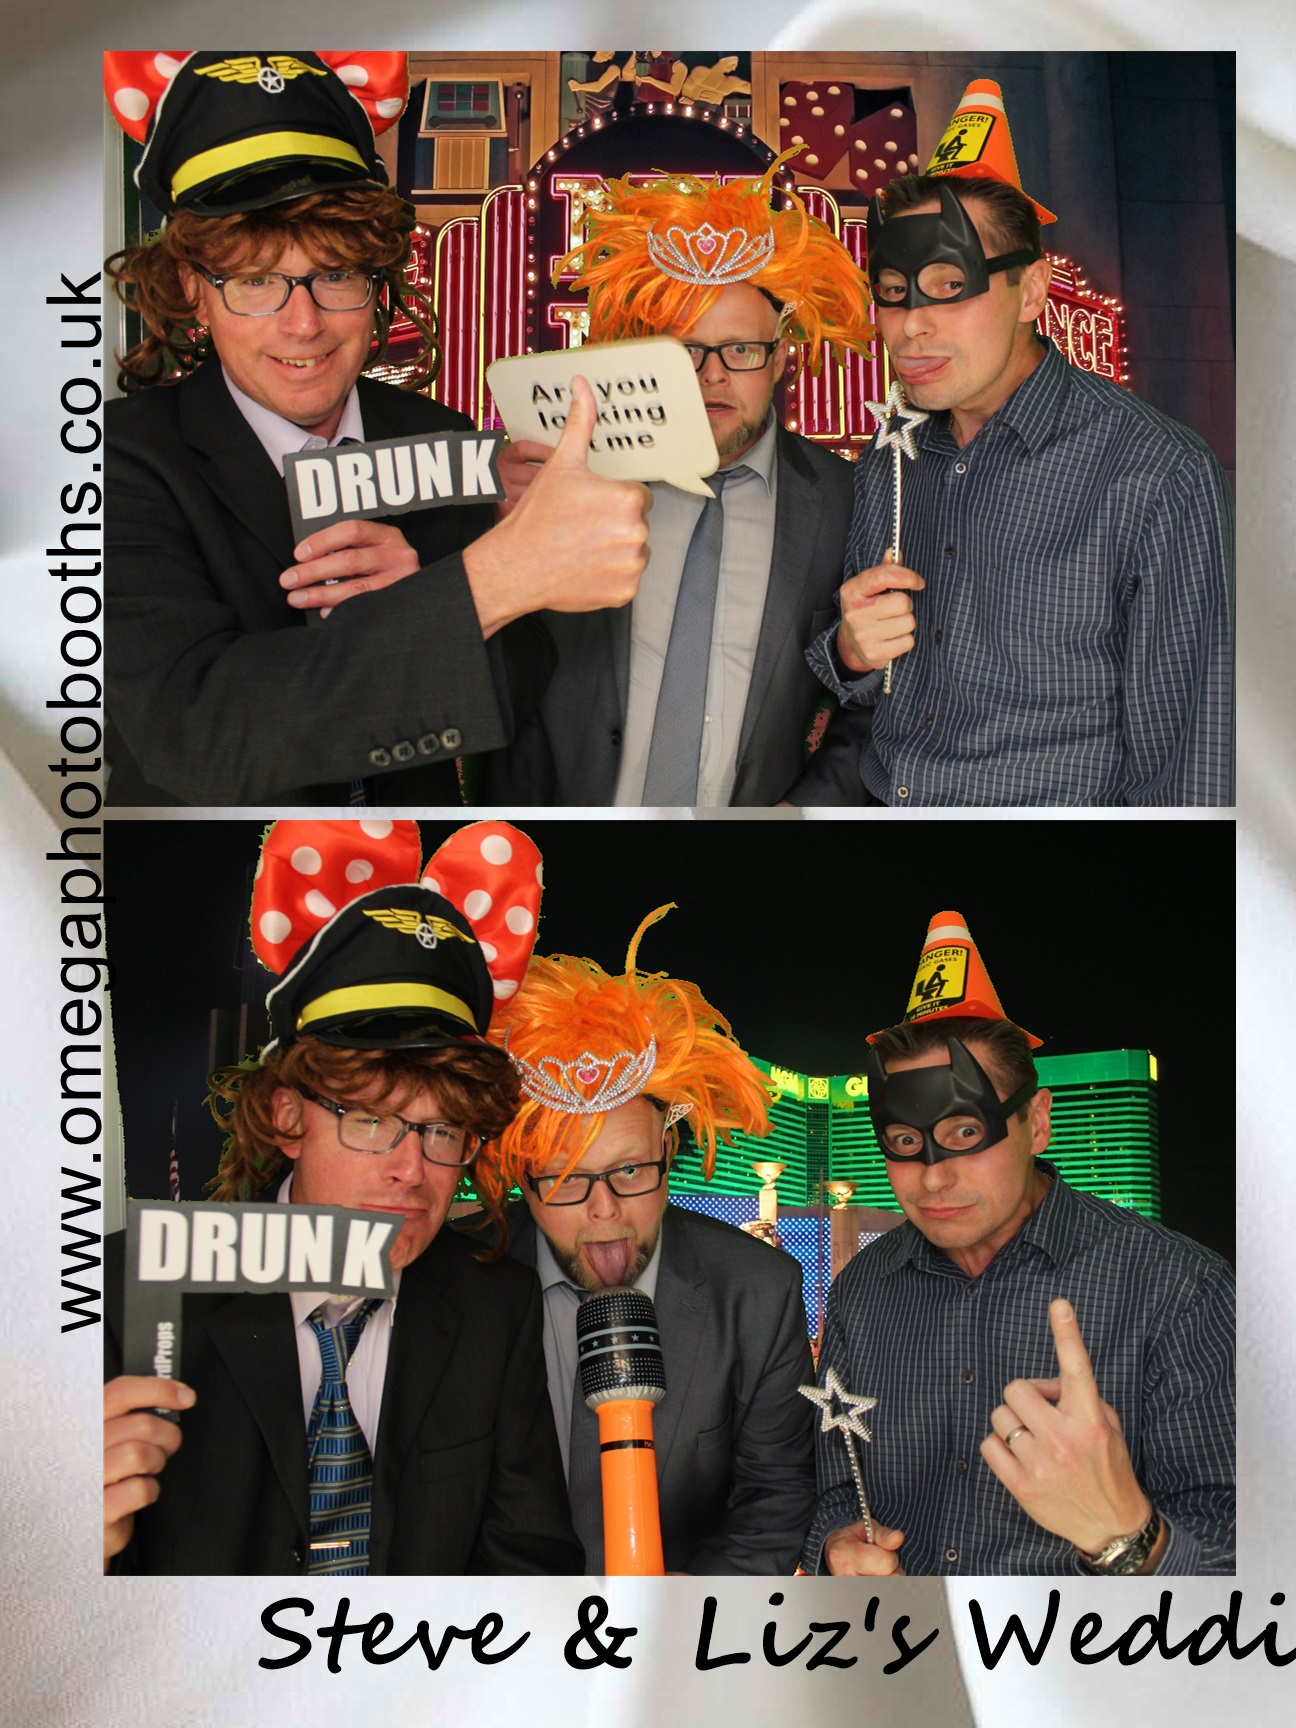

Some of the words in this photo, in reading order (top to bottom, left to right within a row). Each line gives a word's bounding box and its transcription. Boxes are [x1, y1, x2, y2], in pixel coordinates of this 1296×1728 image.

[1038, 299, 1114, 377] NCE
[531, 383, 573, 405] Ar
[596, 376, 660, 404] you
[537, 402, 668, 431] loking
[607, 433, 656, 451] me
[295, 439, 498, 519] DRUNK
[139, 1210, 392, 1289] DRUNK
